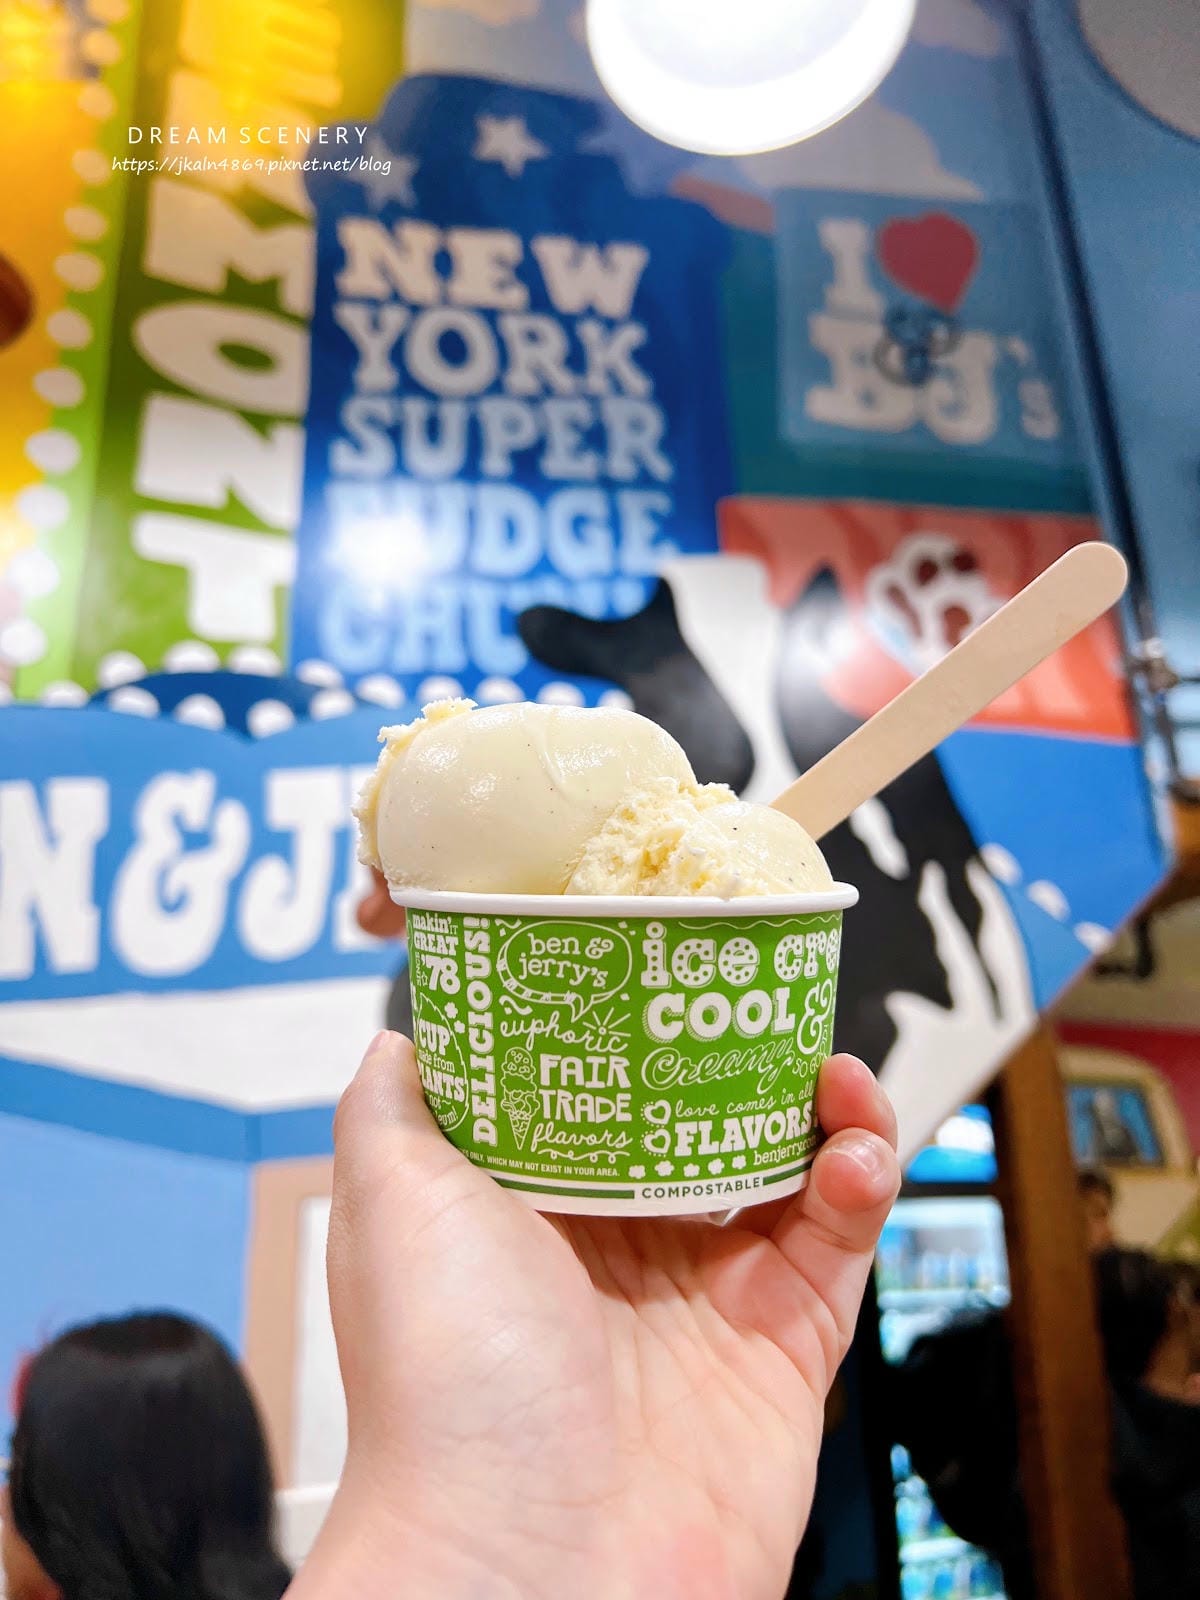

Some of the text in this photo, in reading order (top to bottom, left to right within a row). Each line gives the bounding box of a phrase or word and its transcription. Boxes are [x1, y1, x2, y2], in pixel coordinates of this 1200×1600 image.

[335, 215, 650, 320] NEW
[333, 301, 653, 398] YORK
[329, 396, 674, 483] SUPER
[317, 576, 646, 677] CHU
[413, 933, 459, 956] GREAT
[528, 933, 614, 959] ben &
[641, 921, 840, 989] ice cre
[519, 952, 609, 988] jerry's
[463, 917, 498, 1147] DELICIOUS!
[500, 1010, 629, 1053] euphoric
[642, 978, 833, 1055] COOL &
[418, 1018, 450, 1056] CUP
[433, 1052, 455, 1073] from
[539, 1053, 632, 1088] FAIR
[538, 1089, 633, 1123] TRADE
[675, 1099, 720, 1118] love
[726, 1095, 777, 1114] comes
[781, 1087, 795, 1106] in
[530, 1121, 634, 1152] flavors
[487, 1154, 508, 1167] WHICH
[508, 1159, 524, 1170] MAY
[525, 1161, 539, 1172] NOT
[541, 1163, 562, 1174] EXIST
[564, 1164, 573, 1175] IN
[573, 1165, 596, 1176] YOUR
[596, 1166, 620, 1177] AREA.
[641, 1176, 761, 1199] COMPOSTABLE
